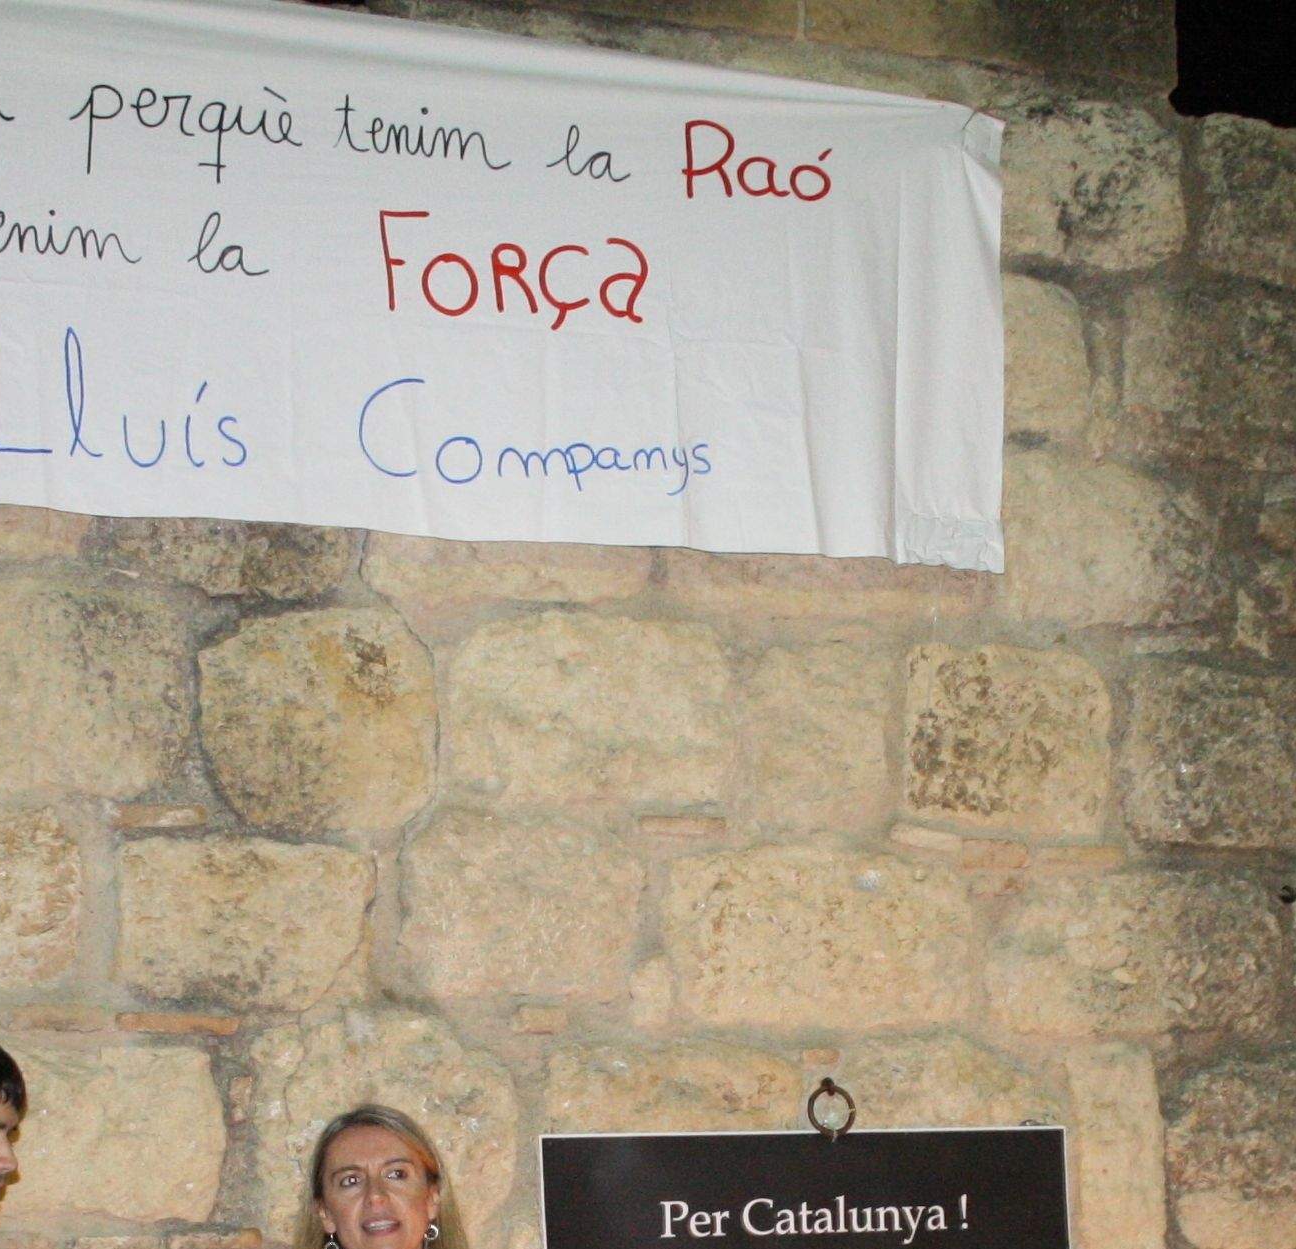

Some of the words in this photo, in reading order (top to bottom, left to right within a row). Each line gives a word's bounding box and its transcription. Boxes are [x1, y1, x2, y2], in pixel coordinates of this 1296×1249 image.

[71, 85, 302, 183] perquè
[334, 94, 510, 170] tenim
[556, 125, 631, 181] la
[681, 119, 832, 200] Raó
[189, 212, 269, 276] la
[358, 378, 712, 496] Companys
[660, 1199, 730, 1238] Per
[741, 1195, 948, 1244] Catalunya
